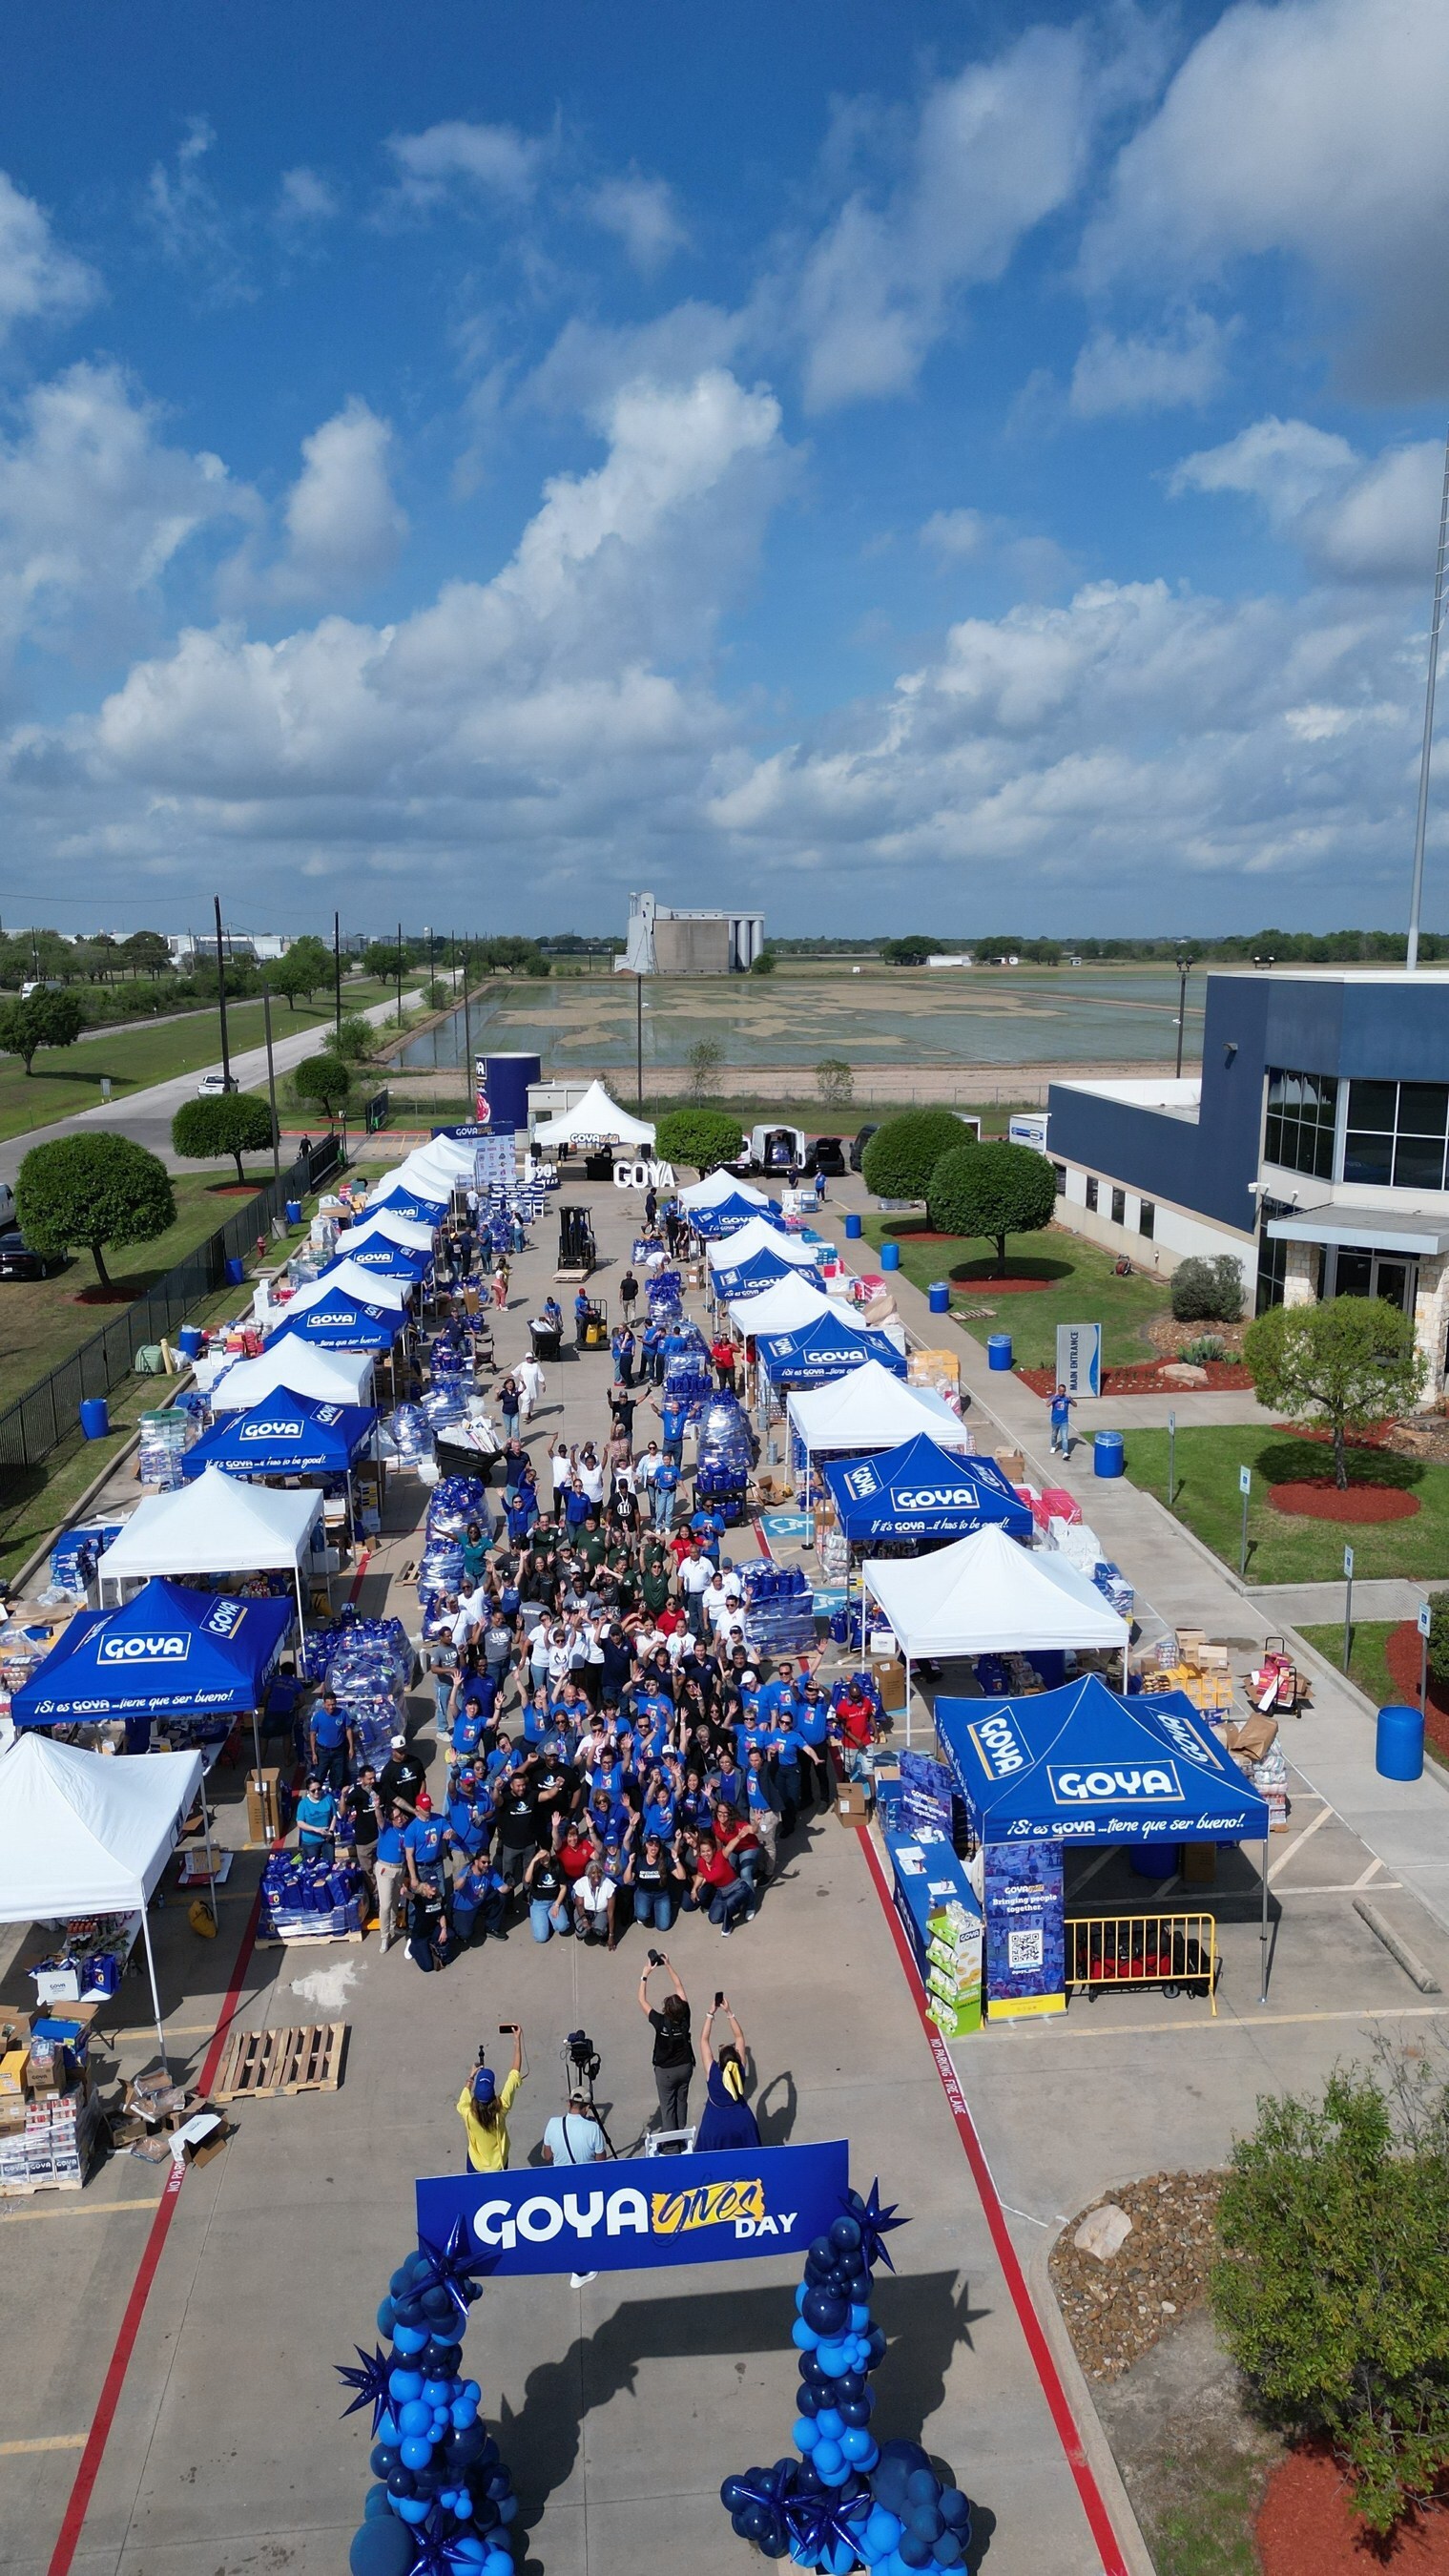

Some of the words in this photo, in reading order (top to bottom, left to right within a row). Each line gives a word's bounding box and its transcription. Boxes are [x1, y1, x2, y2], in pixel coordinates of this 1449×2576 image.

[570, 1133, 599, 1143] GOYA
[613, 1160, 675, 1189] GOYA
[356, 1253, 391, 1263] GOYA
[311, 1314, 354, 1325] GOYA
[808, 1350, 864, 1362] GOYA
[1069, 1332, 1079, 1368] ENTRANCE
[803, 1367, 824, 1376] GOYA
[1069, 1371, 1078, 1391] MAIN
[244, 1423, 300, 1438] GOYA
[226, 1460, 253, 1469] GOYA
[897, 1488, 974, 1508] GOYA
[895, 1521, 924, 1531] GOYA
[940, 1517, 958, 1530] has
[959, 1519, 968, 1529] to
[969, 1516, 981, 1529] be
[207, 1601, 240, 1632] GOYA
[104, 1636, 184, 1659] GOYA
[34, 1699, 55, 1714] ¡Si
[56, 1701, 70, 1714] es
[72, 1698, 110, 1713] GOYA
[148, 1695, 170, 1712] que
[172, 1693, 193, 1705] ser
[195, 1688, 234, 1703] bueno!
[979, 1717, 1025, 1775] GOYA
[1156, 1714, 1209, 1763] GOYA
[1058, 1769, 1175, 1798] GOYA
[1006, 1819, 1032, 1836] ¡Si
[1033, 1823, 1049, 1835] es
[1052, 1820, 1095, 1834] GOYA
[1141, 1820, 1171, 1839] que
[1172, 1819, 1193, 1831] ser
[1196, 1812, 1244, 1830] bueno!
[1004, 1885, 1029, 1895] GOYA
[992, 1896, 1029, 1906] Bringing
[1030, 1893, 1058, 1904] people
[1006, 1904, 1044, 1914] together.
[960, 1930, 980, 1942] GOYA
[930, 2038, 942, 2048] NO
[934, 2049, 952, 2077] PARKING
[943, 2079, 959, 2094] FIRE
[949, 2095, 965, 2114] LANE
[31, 2161, 52, 2170] GOYA
[167, 2180, 181, 2192] NO
[473, 2188, 649, 2250] GOYA
[652, 2172, 763, 2246] gives
[735, 2212, 798, 2239] DAY
